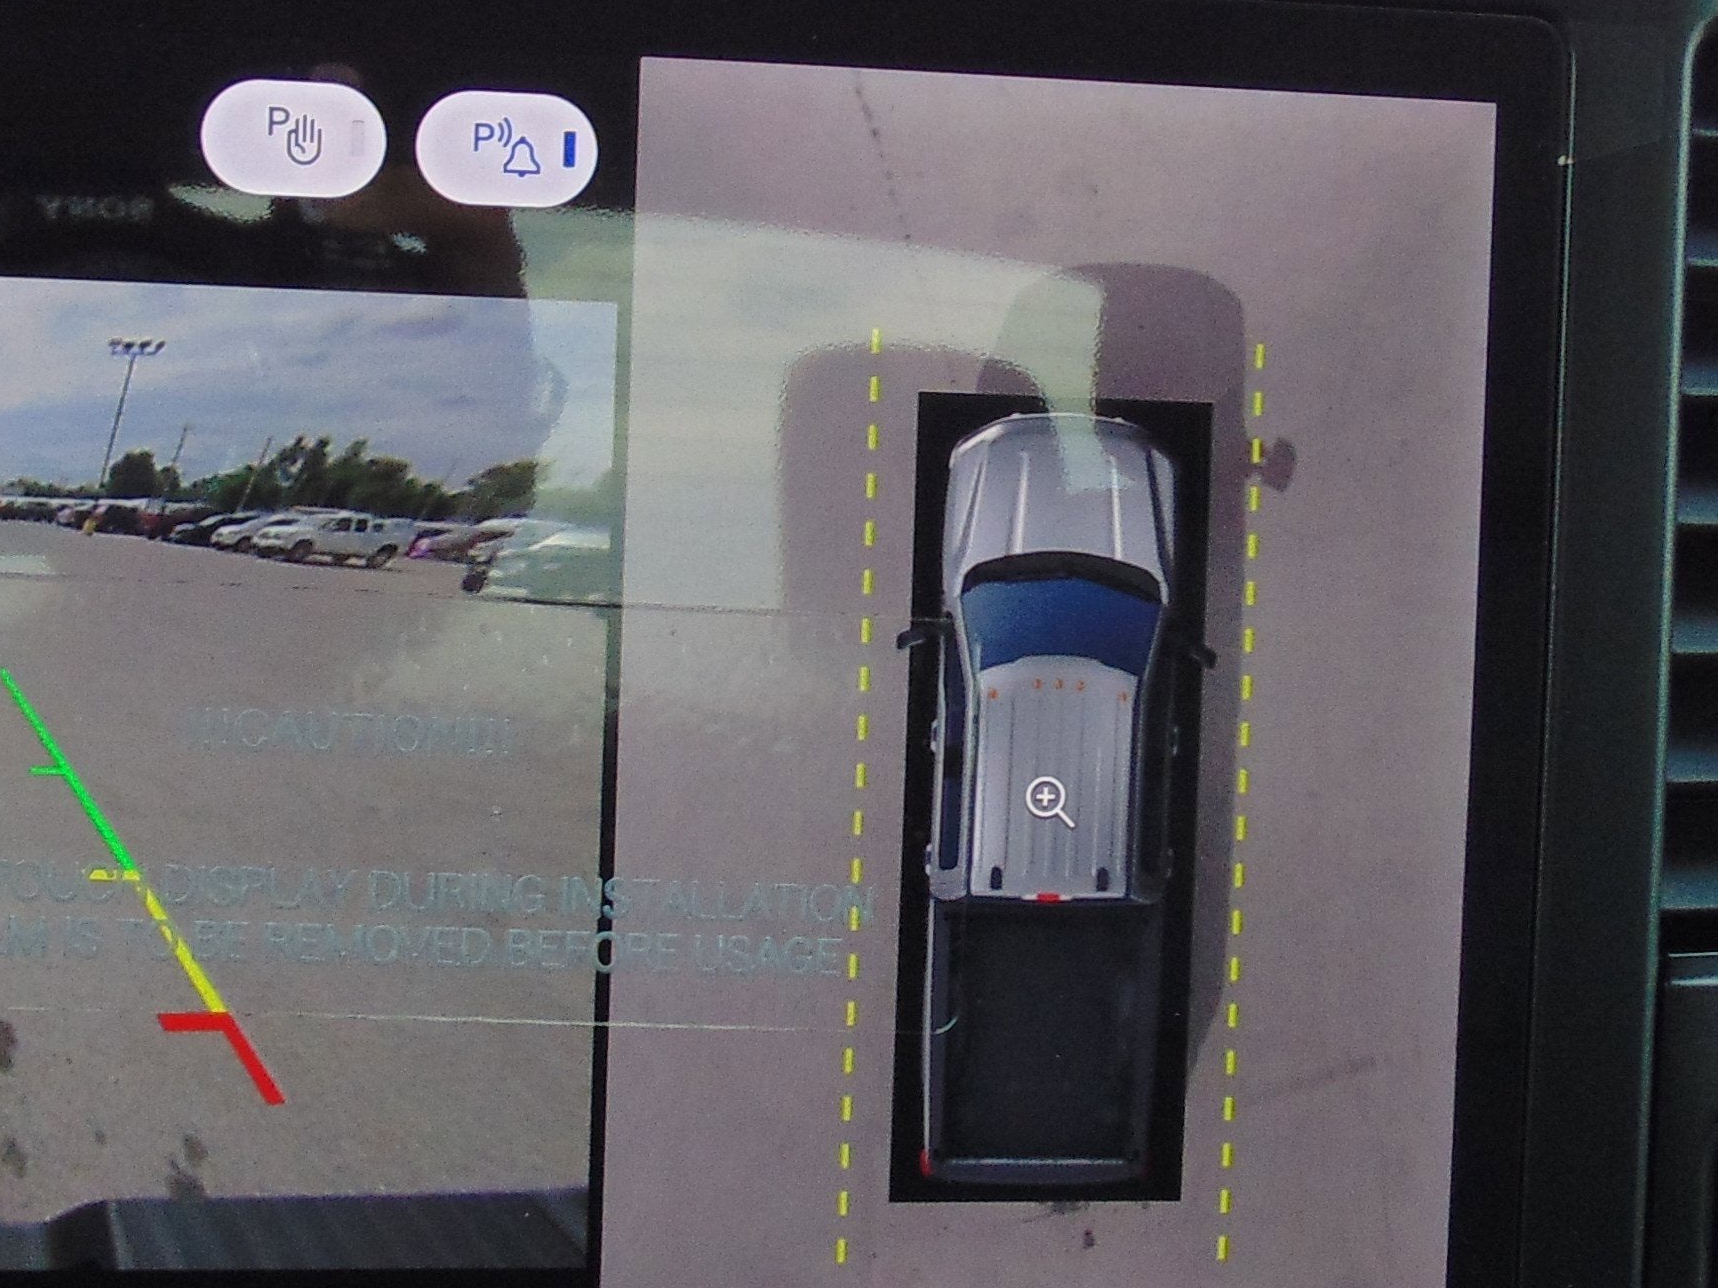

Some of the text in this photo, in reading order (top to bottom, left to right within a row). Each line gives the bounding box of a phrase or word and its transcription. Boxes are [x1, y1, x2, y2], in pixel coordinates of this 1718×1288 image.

[162, 862, 359, 912] DISPLAY
[368, 867, 545, 916] DURING
[560, 873, 877, 925] INSTALLATION
[63, 914, 102, 959] IS
[117, 916, 177, 961] TO
[192, 918, 252, 962] BE
[263, 920, 492, 968] REMOVED
[507, 927, 682, 974] BEFORE
[694, 933, 845, 978] USAGE
